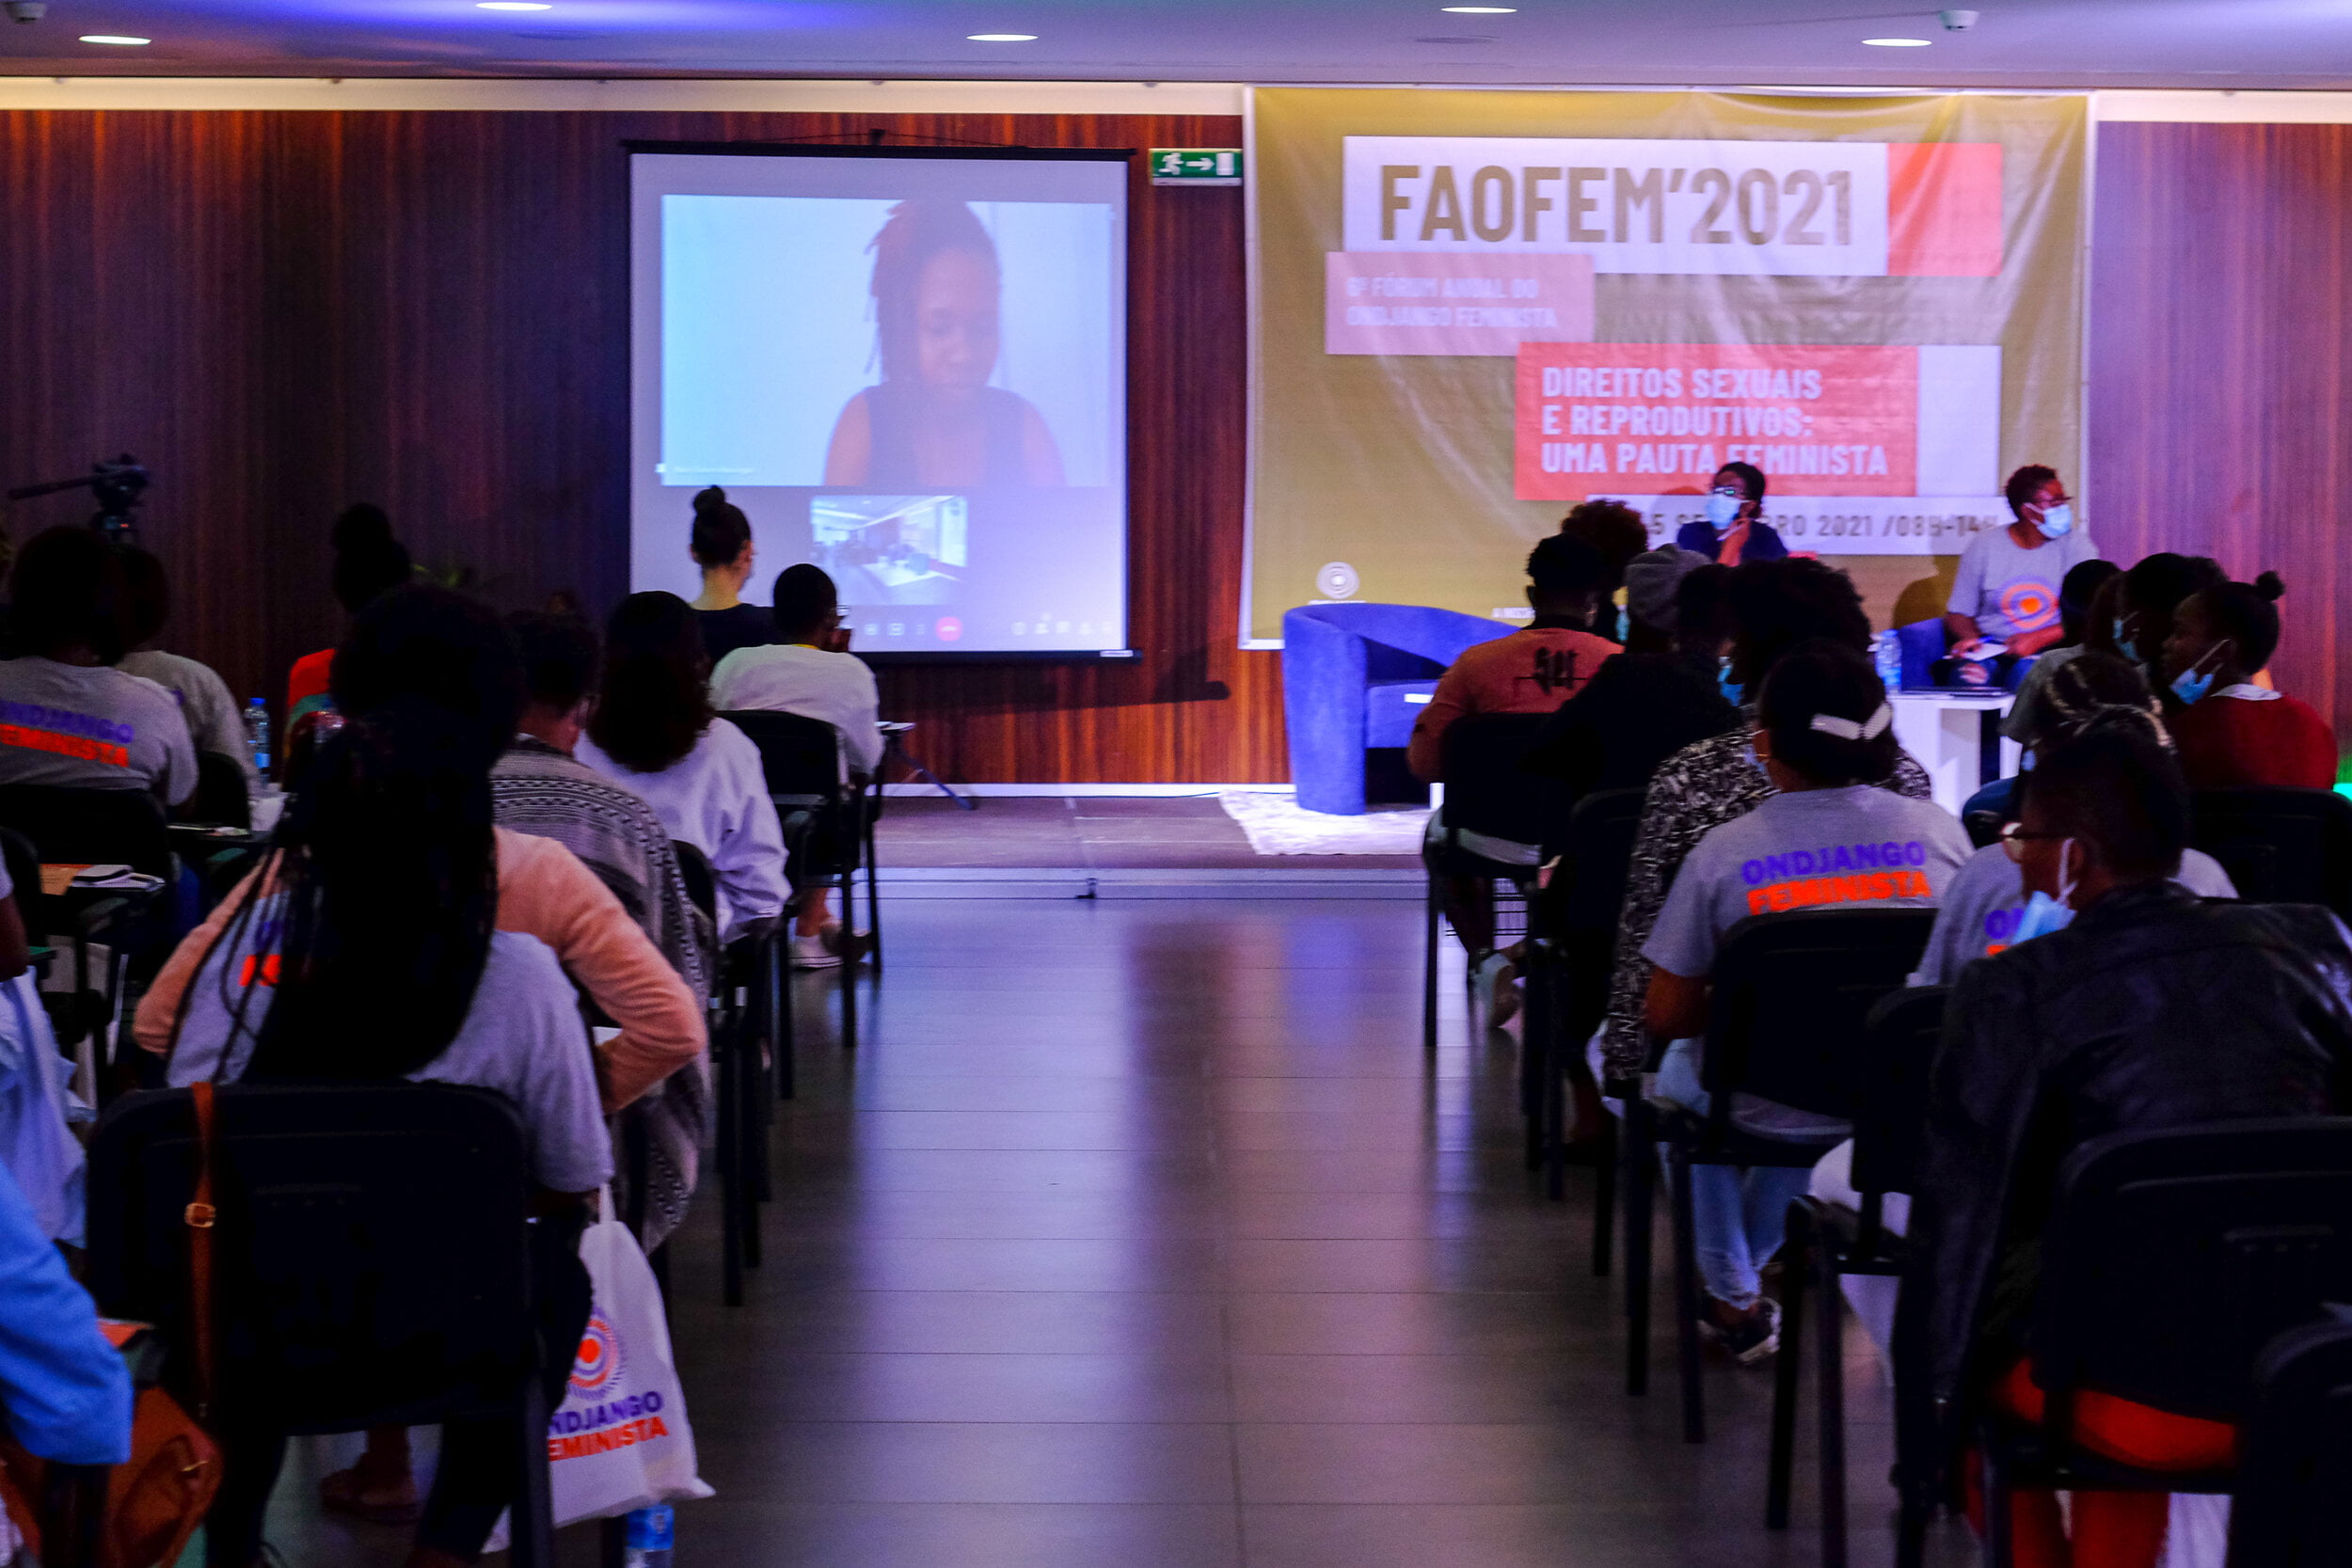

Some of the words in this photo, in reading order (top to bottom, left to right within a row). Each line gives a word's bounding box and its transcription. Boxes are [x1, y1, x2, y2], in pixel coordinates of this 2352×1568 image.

[1543, 367, 1682, 398] DIREITOS
[1692, 369, 1822, 399] SEXUAIS
[1543, 405, 1563, 436] E
[1571, 405, 1813, 436] REPRODUTIVOS:
[1542, 443, 1607, 474] UMA
[1616, 443, 1718, 475] PAUTA
[1818, 515, 1872, 536] 2021
[1742, 842, 1926, 885] ONDJANGO
[1747, 871, 1931, 915] FEMINISTA
[549, 1391, 662, 1434] NDJANGO
[548, 1417, 669, 1462] EMINISTA
